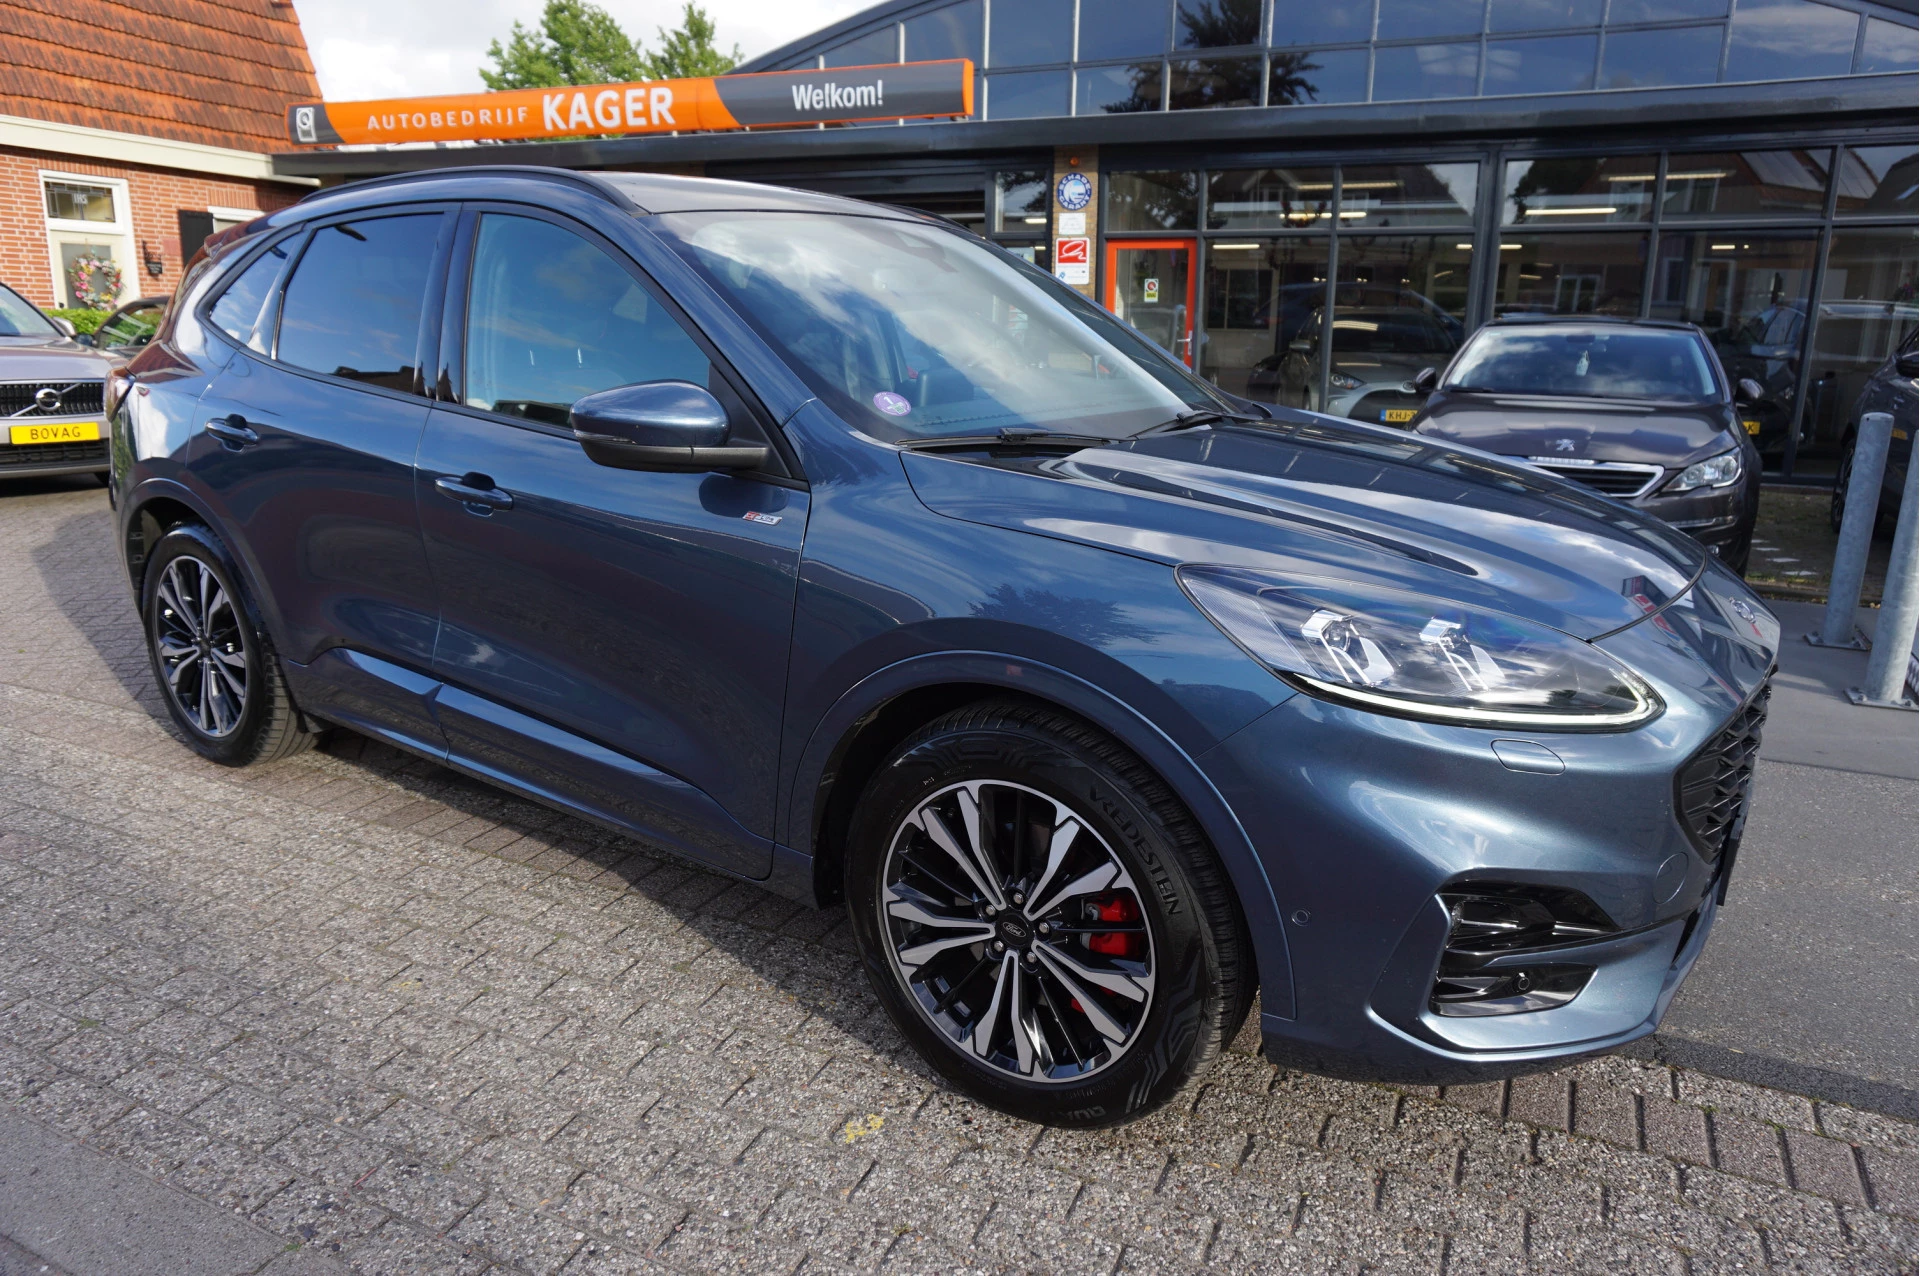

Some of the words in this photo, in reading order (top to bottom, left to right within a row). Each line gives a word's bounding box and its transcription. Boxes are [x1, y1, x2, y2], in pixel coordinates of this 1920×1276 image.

[367, 106, 528, 130] AUTOBEDRIJF
[543, 87, 676, 130] KAGER
[792, 80, 883, 111] Welkom!
[1059, 174, 1091, 190] SCHADE
[30, 427, 80, 440] BOVAG
[1090, 784, 1183, 916] VREDESTEIN
